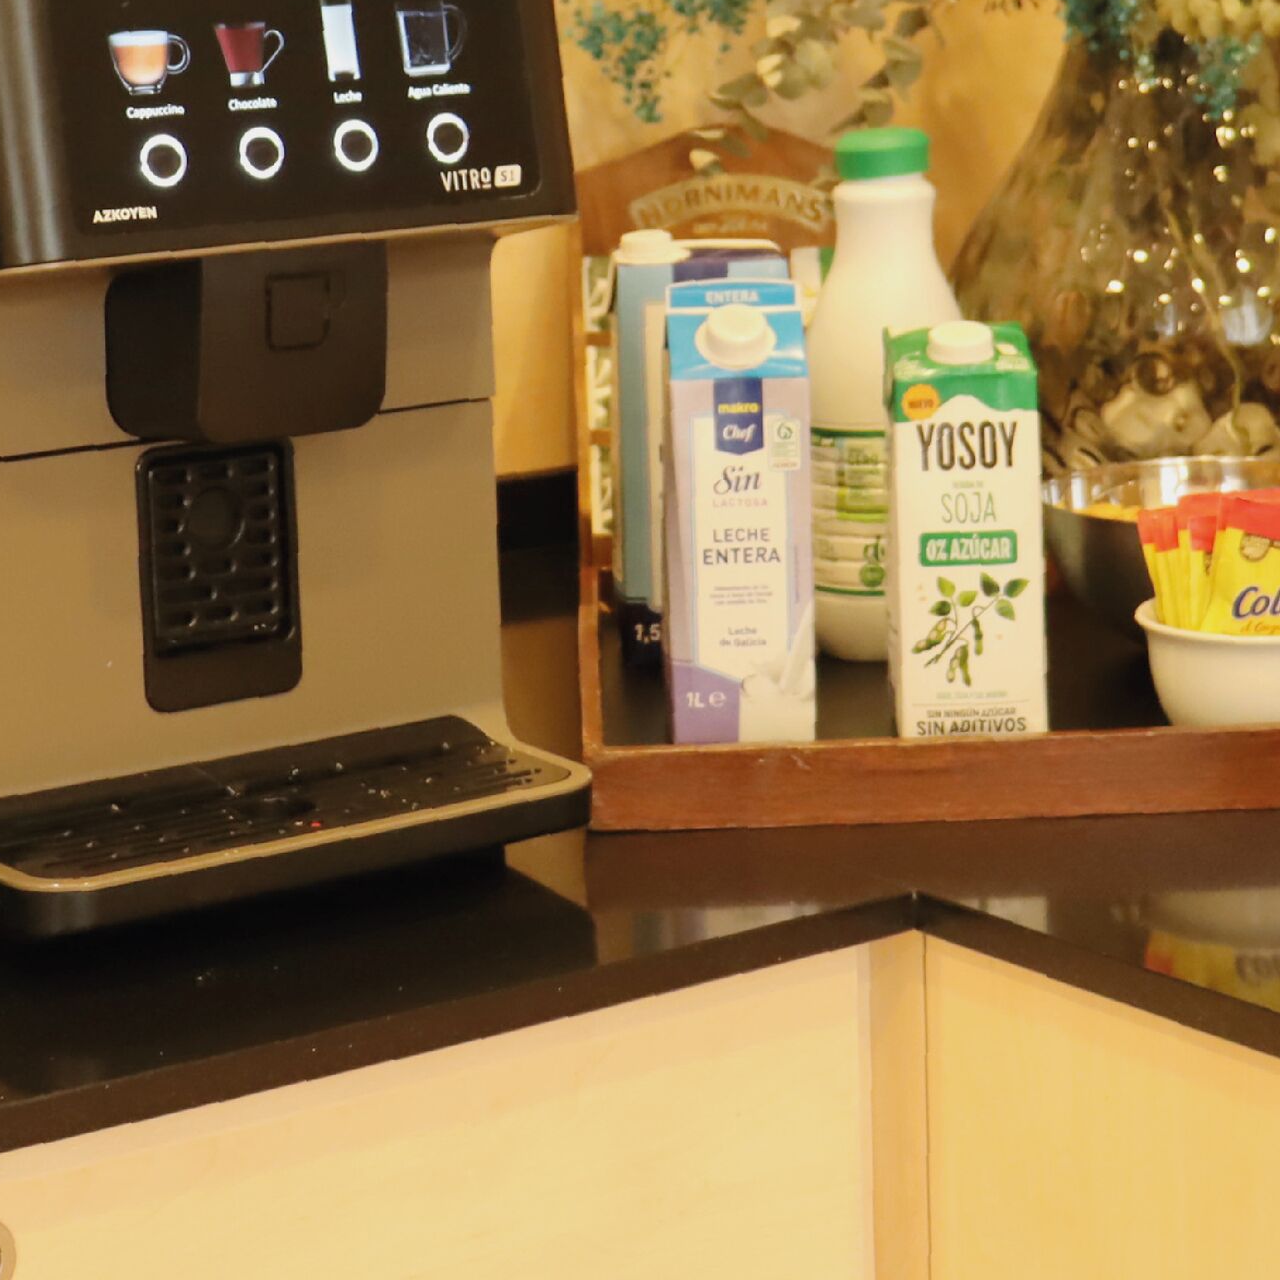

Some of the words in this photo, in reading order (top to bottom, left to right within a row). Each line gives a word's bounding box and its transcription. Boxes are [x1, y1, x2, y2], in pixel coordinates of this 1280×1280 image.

[333, 89, 362, 104] Leche
[432, 83, 471, 96] Caliente
[126, 104, 185, 120] Cappuccino
[228, 97, 278, 111] Chocolate
[440, 167, 491, 192] VITRO
[93, 205, 158, 224] AZKOYEN
[705, 288, 759, 304] ENTERA
[718, 402, 759, 414] makro
[722, 423, 757, 442] Chef
[916, 420, 1017, 472] YOSOY
[712, 464, 761, 495] Sin
[712, 498, 769, 508] LACTOSA
[940, 491, 997, 524] SOJA
[712, 527, 771, 543] LECHE
[702, 546, 781, 566] ENTERA
[925, 538, 948, 562] 0%
[949, 533, 1012, 561] AZÚCAR
[727, 626, 758, 636] Leche
[686, 691, 705, 708] 1L
[916, 720, 945, 736] SIN
[949, 716, 1027, 734] ADITIVOS
